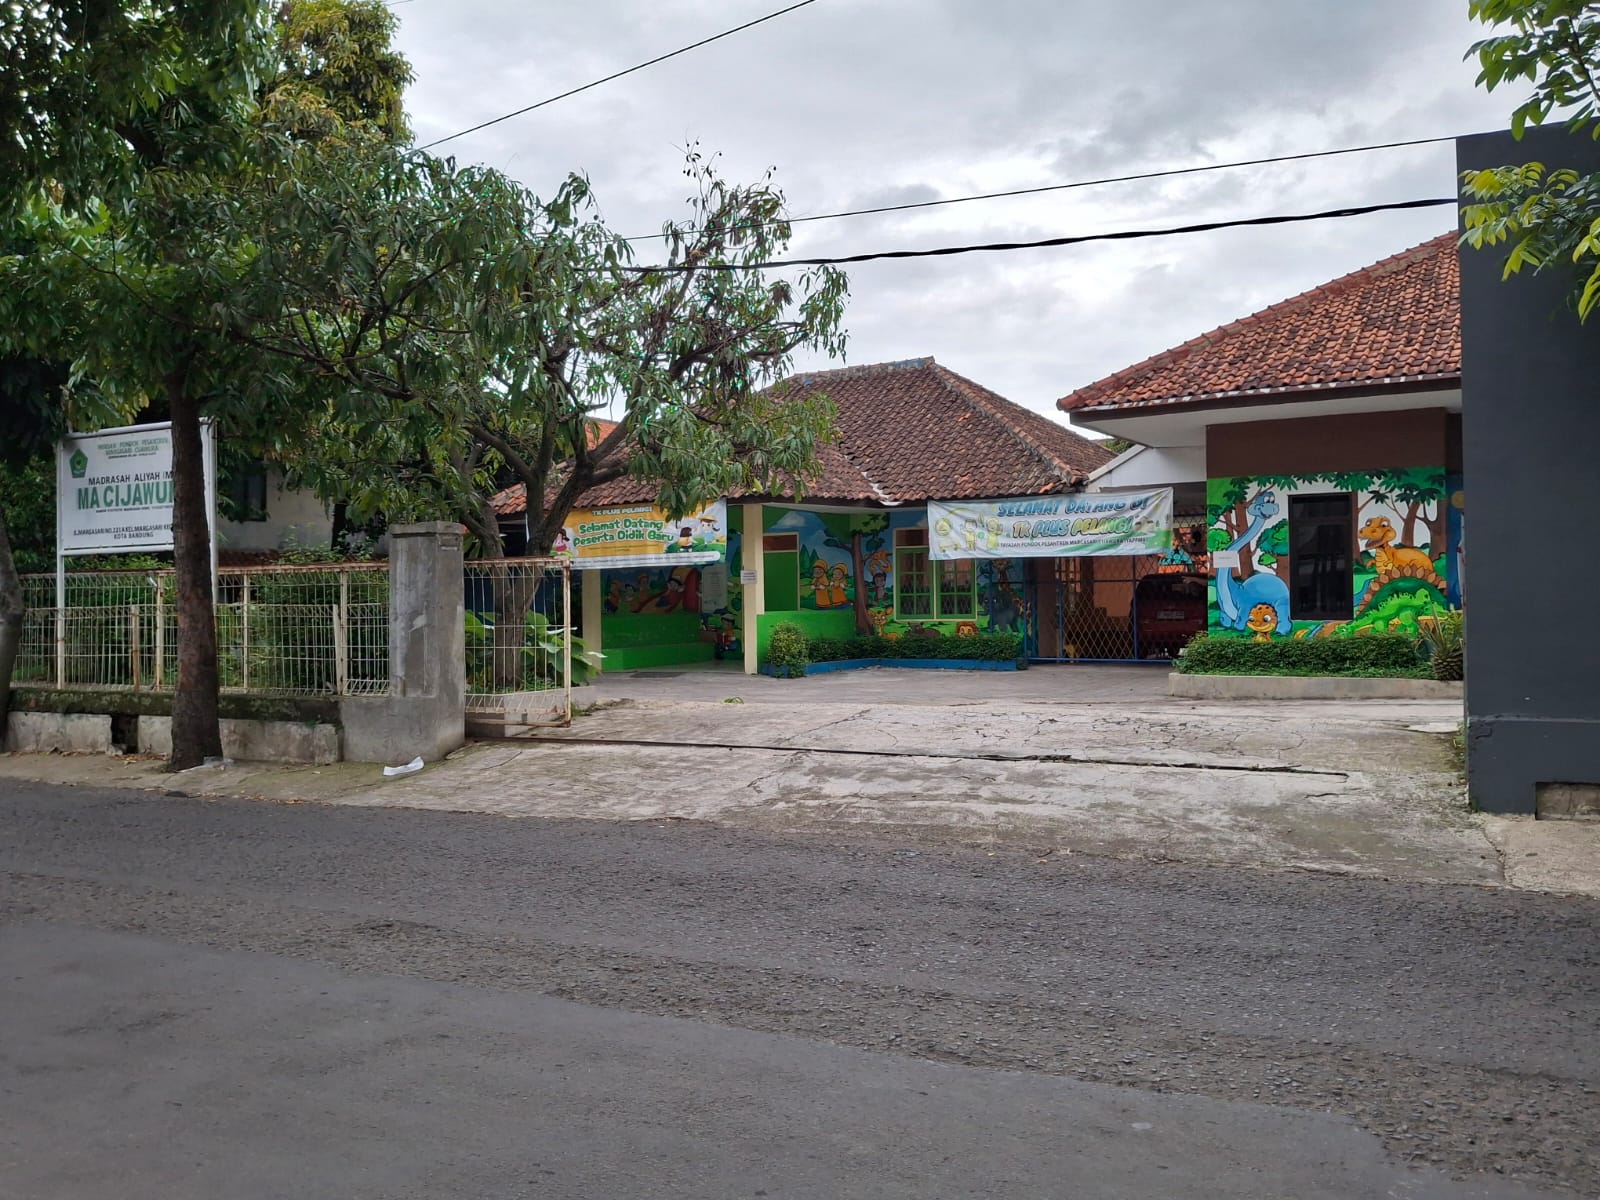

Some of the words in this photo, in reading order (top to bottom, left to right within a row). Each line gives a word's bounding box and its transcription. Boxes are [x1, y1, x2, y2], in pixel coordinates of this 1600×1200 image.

[88, 474, 130, 485] MADRASAH
[134, 471, 160, 481] ALIYAH
[78, 486, 100, 510] MA
[592, 509, 602, 517] TK
[602, 508, 621, 516] PLUS
[622, 506, 653, 514] PELANGI
[997, 499, 1060, 517] SELAMAT
[579, 518, 621, 534] Selamat
[623, 517, 665, 531] Datang
[1013, 520, 1032, 539] TK
[1031, 518, 1070, 539] PLUS
[1070, 515, 1134, 537] PELANGI
[129, 531, 154, 539] BANDUNG
[573, 532, 615, 547] Peserta
[617, 528, 645, 541] Didik
[647, 529, 674, 543] Baru
